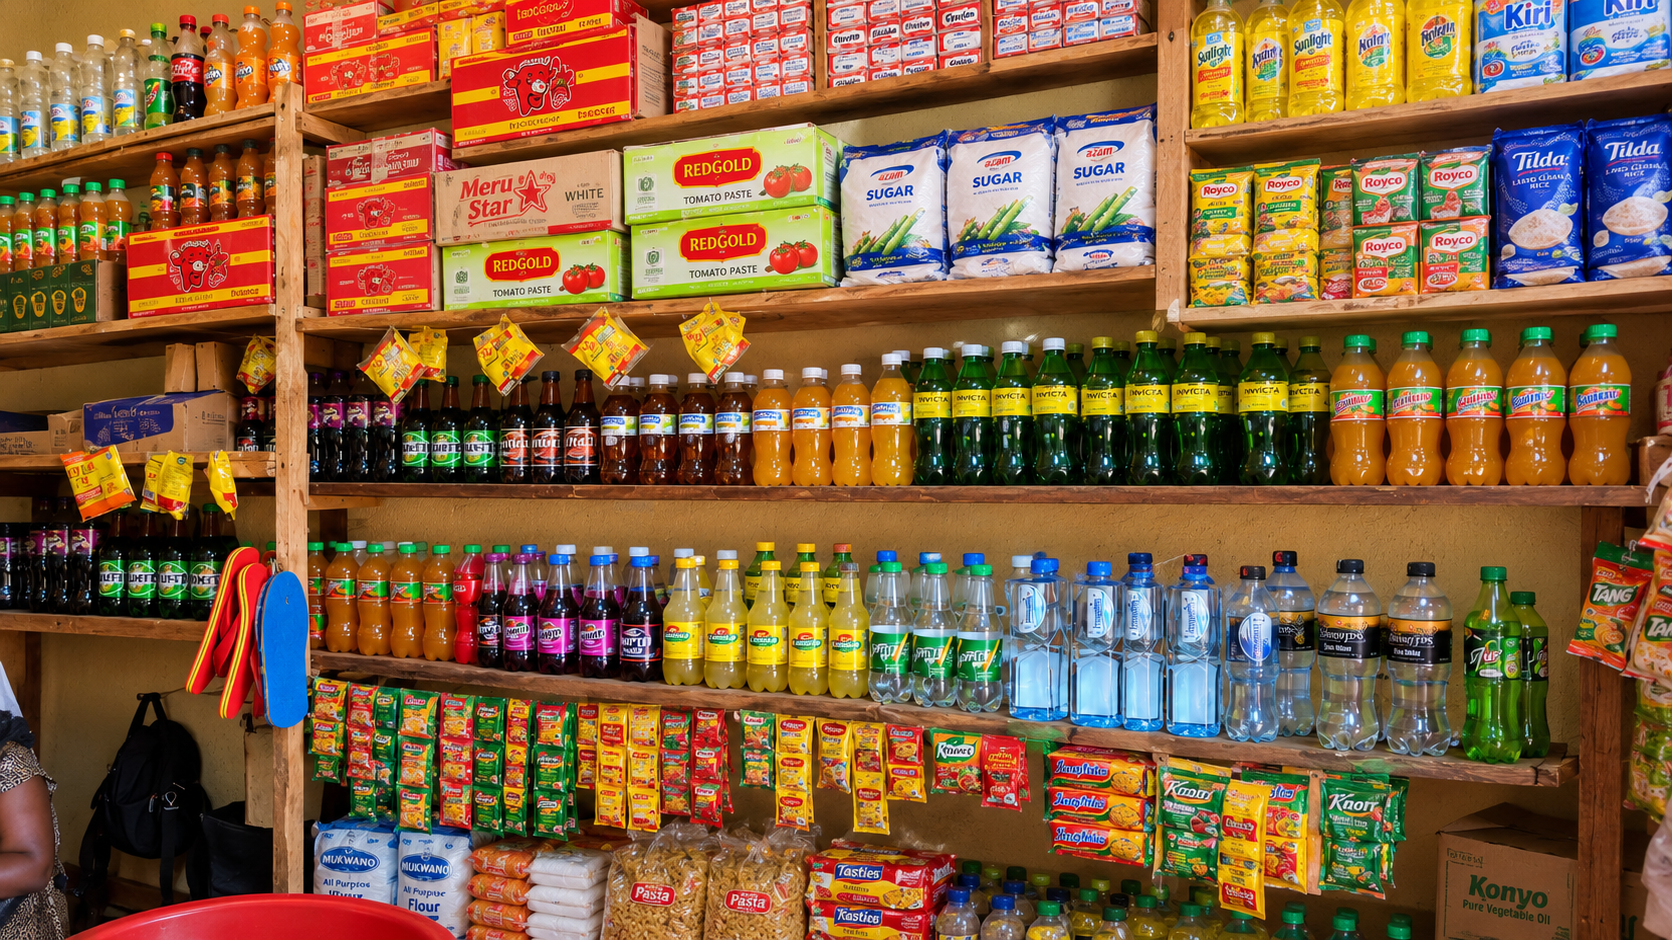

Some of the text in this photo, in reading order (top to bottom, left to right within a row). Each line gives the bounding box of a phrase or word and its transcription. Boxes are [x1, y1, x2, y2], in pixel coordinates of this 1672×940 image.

[1504, 1, 1553, 30] Kiri
[1294, 32, 1332, 56] Sunlight
[1604, 140, 1661, 161] Tilda
[683, 156, 752, 178] REDGOLD
[1512, 151, 1566, 171] Tilda
[1073, 161, 1125, 180] SUGAR
[1434, 170, 1473, 183] Royco
[972, 171, 1022, 188] SUGAR
[1267, 178, 1300, 191] Royco
[1365, 176, 1402, 189] Royco
[460, 178, 513, 200] Meru
[565, 188, 604, 202] WHITE
[683, 189, 752, 205] TOMATO PASTE
[866, 184, 914, 201] SUGAR
[1203, 185, 1235, 197] Royco
[468, 198, 513, 220] Star
[690, 232, 757, 252] REDGOLD
[1365, 241, 1402, 253] Royco
[1435, 235, 1473, 249] Royco
[493, 255, 551, 273] REDGOLD
[689, 265, 758, 279] TOMATO PASTE
[493, 285, 552, 298] TOMATO PASTE
[1593, 583, 1634, 603] TANG
[1647, 617, 1672, 637] TAN
[322, 855, 376, 867] MUKWANO
[837, 864, 879, 879] Tasties
[323, 878, 334, 886] All
[635, 886, 670, 902] Pasta
[1468, 874, 1548, 910] Konyo
[408, 898, 441, 913] Flour
[730, 893, 766, 909] Pasta
[1462, 899, 1484, 912] Pure
[1486, 903, 1534, 922] Vegetable
